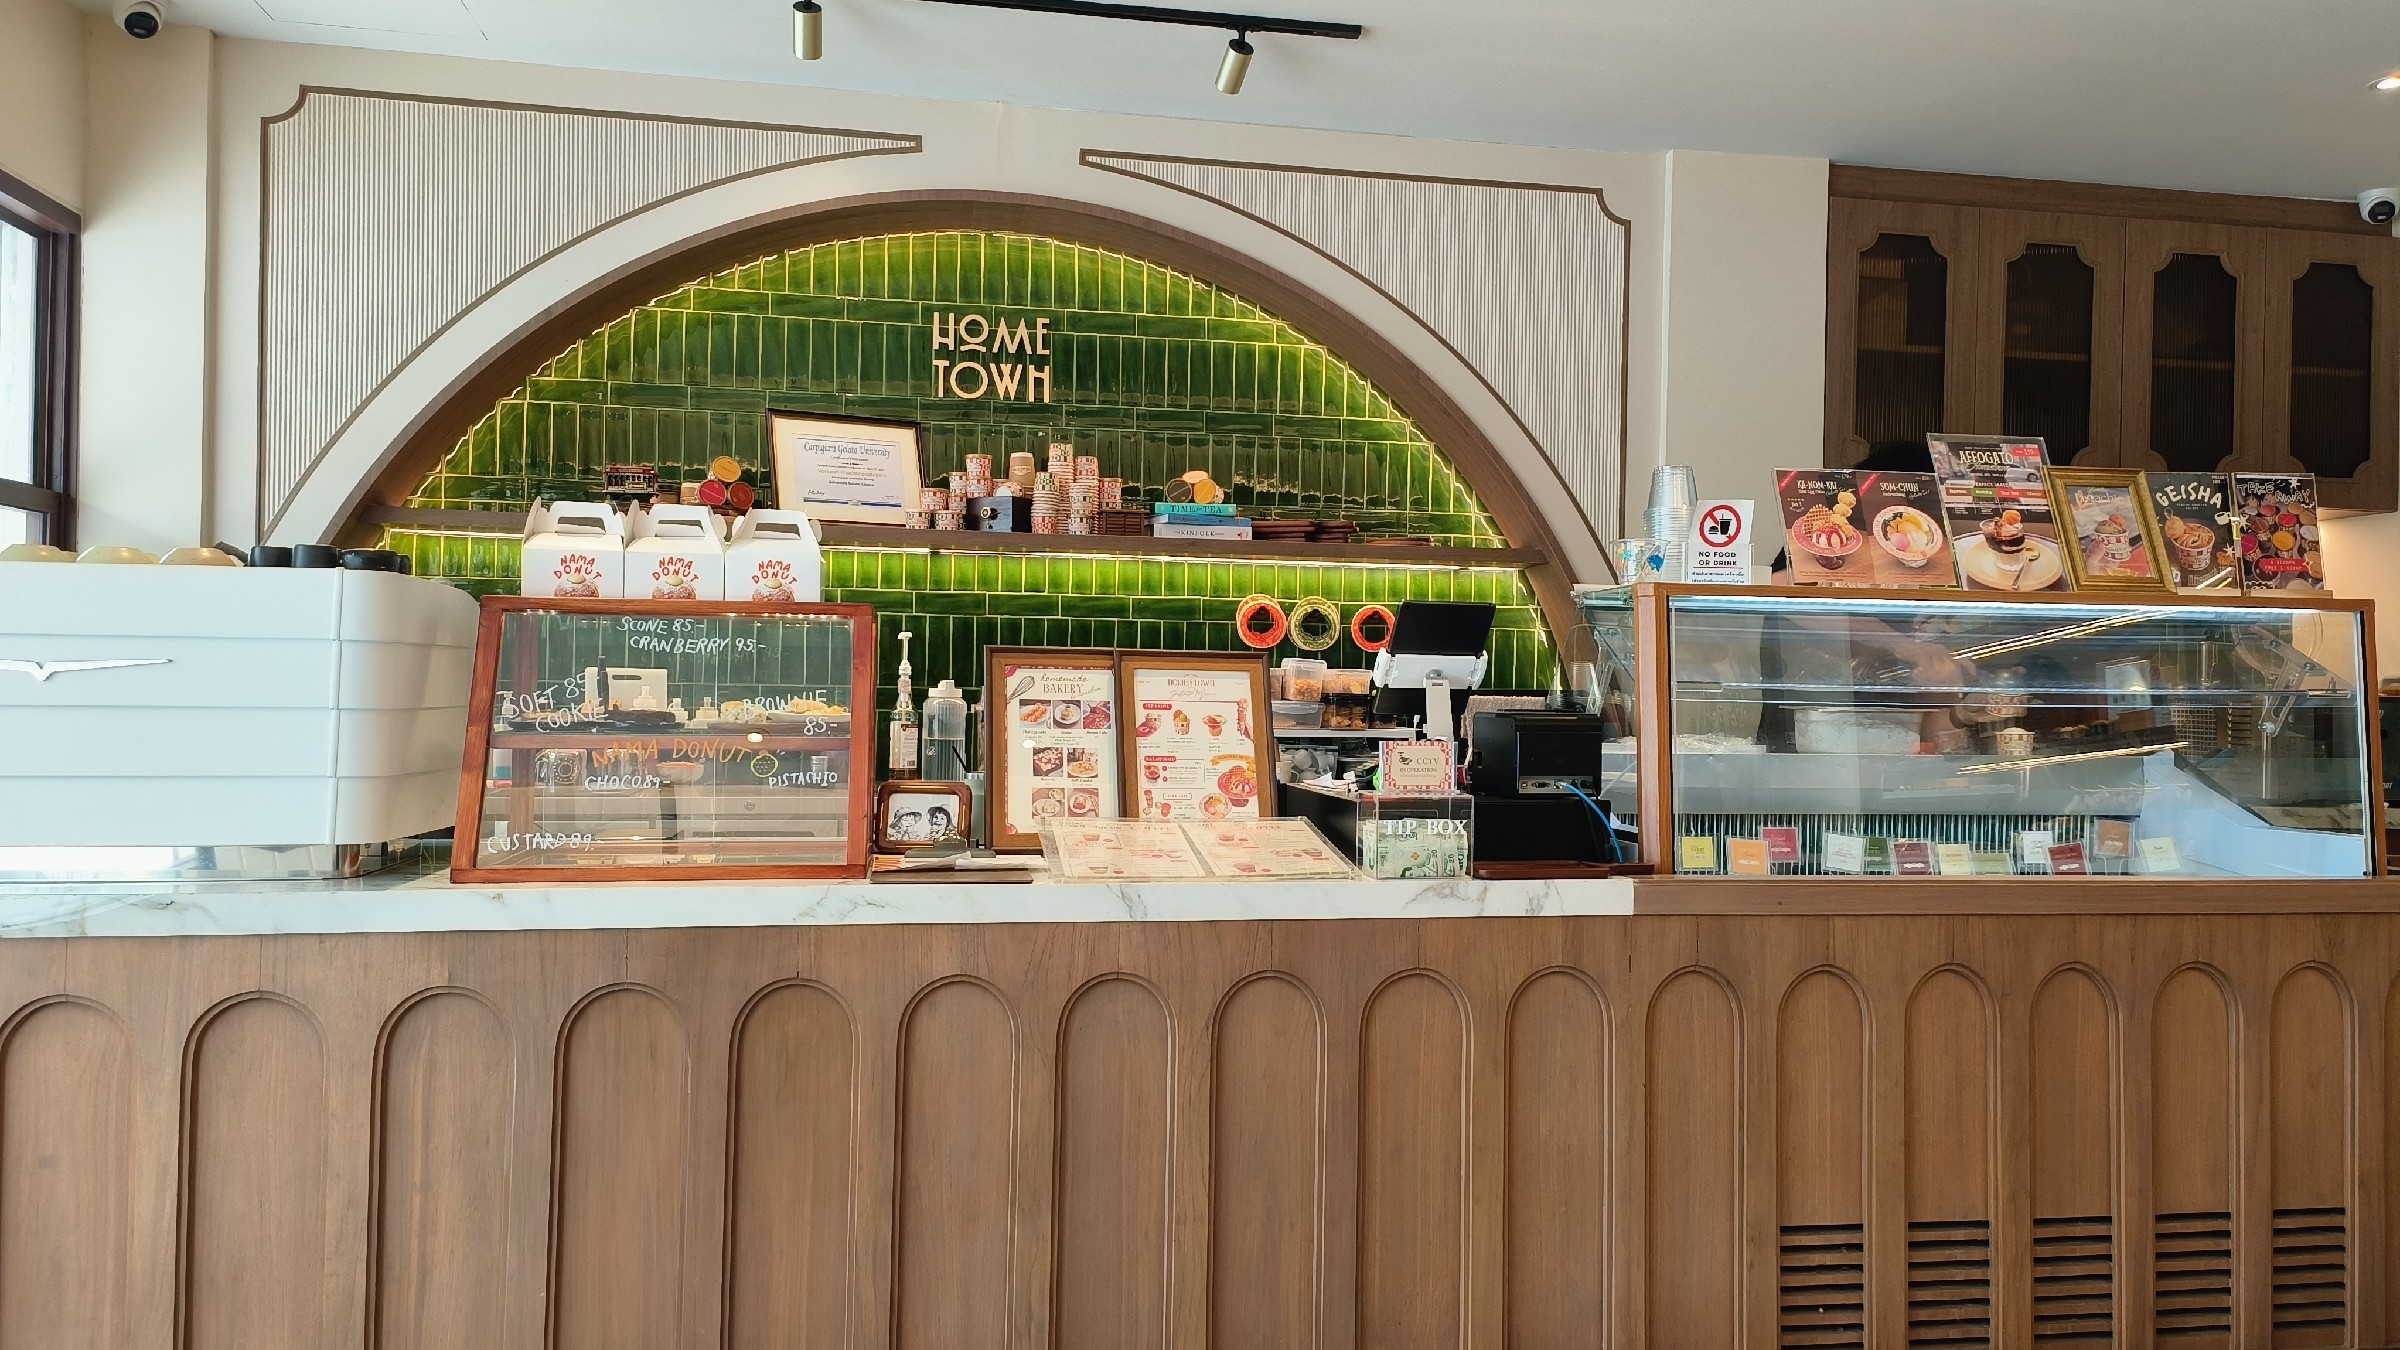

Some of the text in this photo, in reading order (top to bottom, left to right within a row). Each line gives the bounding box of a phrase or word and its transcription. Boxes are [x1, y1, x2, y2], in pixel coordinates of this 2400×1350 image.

[932, 312, 1050, 355] HOME
[932, 360, 1050, 403] TOWN
[1958, 450, 2014, 466] AFFOGATO
[2156, 482, 2222, 509] GEISHA
[2236, 481, 2276, 497] TAKE
[1170, 504, 1196, 513] TIME
[1203, 505, 1223, 514] TEA
[560, 553, 596, 568] NAMA
[658, 556, 694, 571] NAMA
[758, 559, 791, 573] NAMA
[553, 565, 603, 581] DONUT
[652, 566, 699, 582] DONUT
[751, 569, 798, 585] DONUT
[616, 616, 668, 635] SCONE
[629, 635, 730, 655] CRANBERRY
[1043, 683, 1083, 694] BAKERY
[496, 684, 559, 719] SOFT
[535, 697, 609, 733] COOKIE
[591, 737, 752, 768] NAMA DONUT
[1416, 757, 1440, 765] CCTV
[584, 774, 642, 792] CHOCO
[768, 770, 838, 790] PISTACHIO
[1383, 820, 1468, 835] TIP BOX
[486, 832, 567, 854] CUSTARD
